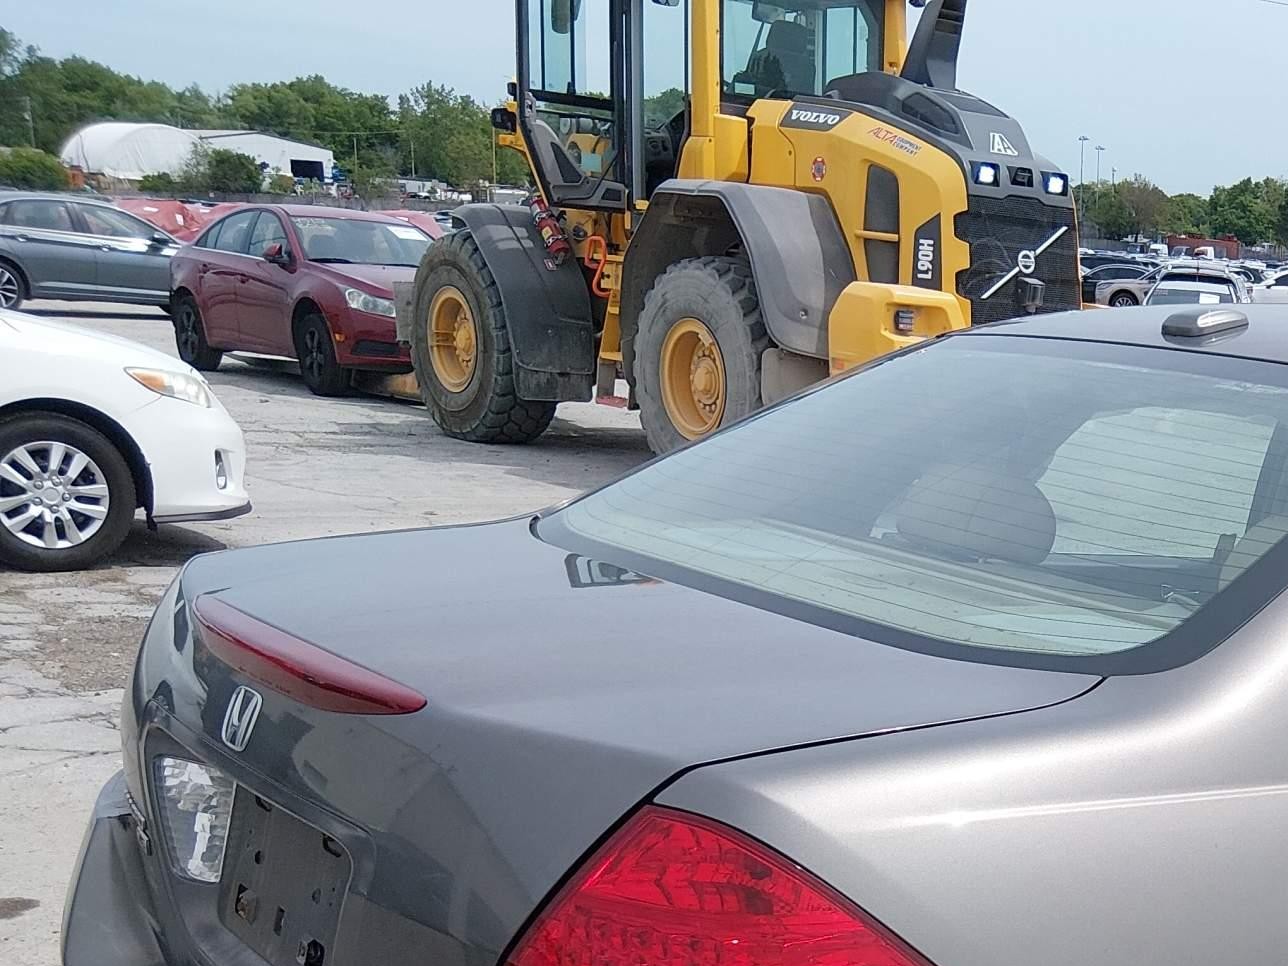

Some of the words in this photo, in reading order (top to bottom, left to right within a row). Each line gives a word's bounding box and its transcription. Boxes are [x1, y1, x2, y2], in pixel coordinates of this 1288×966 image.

[791, 109, 840, 124] VOLVO
[867, 126, 898, 145] ALTA
[916, 238, 935, 280] L90H
